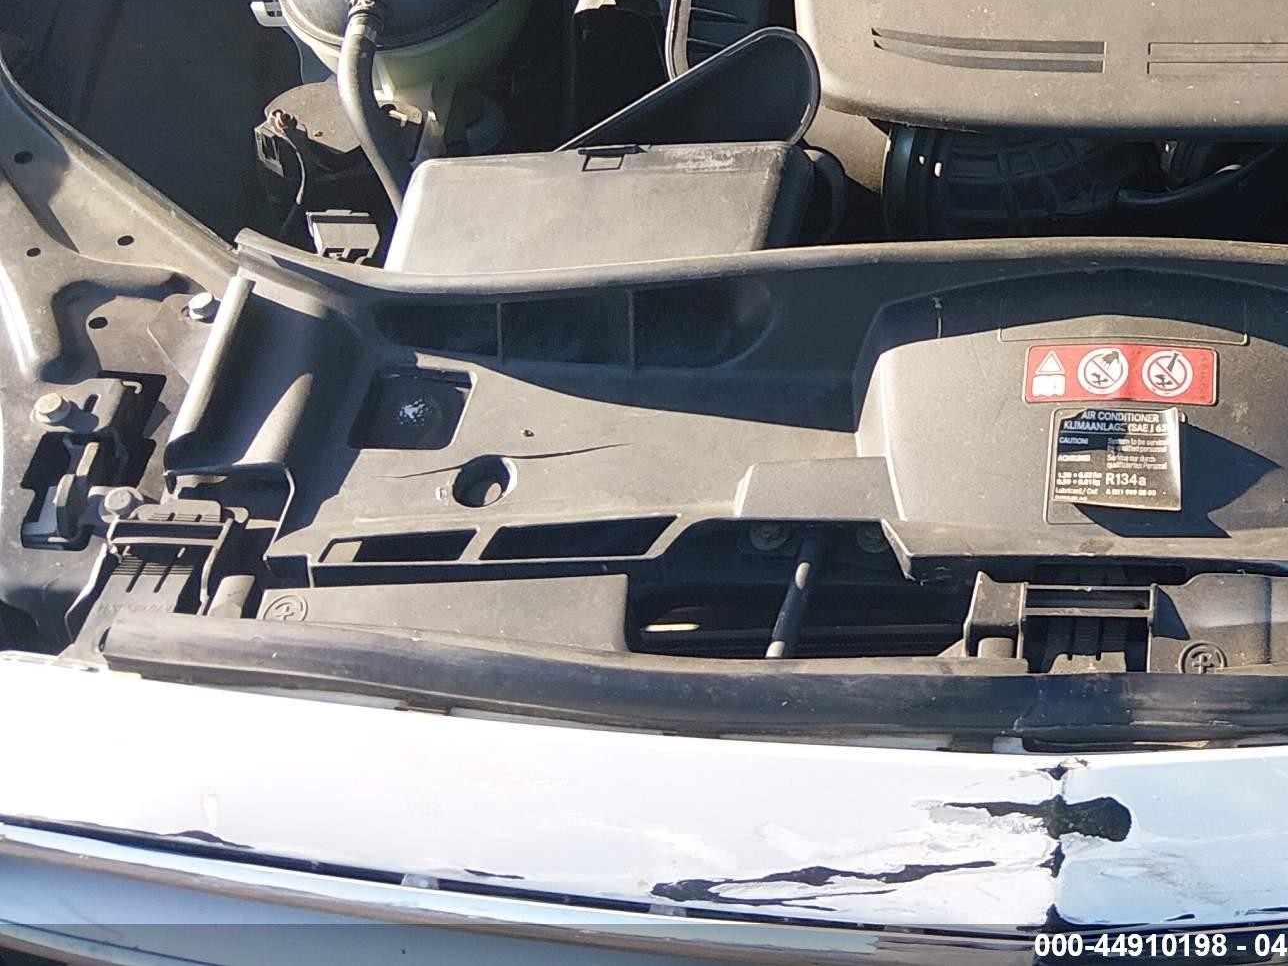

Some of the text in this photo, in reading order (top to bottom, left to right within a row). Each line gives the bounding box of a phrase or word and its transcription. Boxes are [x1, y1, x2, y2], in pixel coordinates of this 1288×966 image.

[1081, 411, 1159, 423] AIR CONDITIONER
[1105, 472, 1147, 487] R134a
